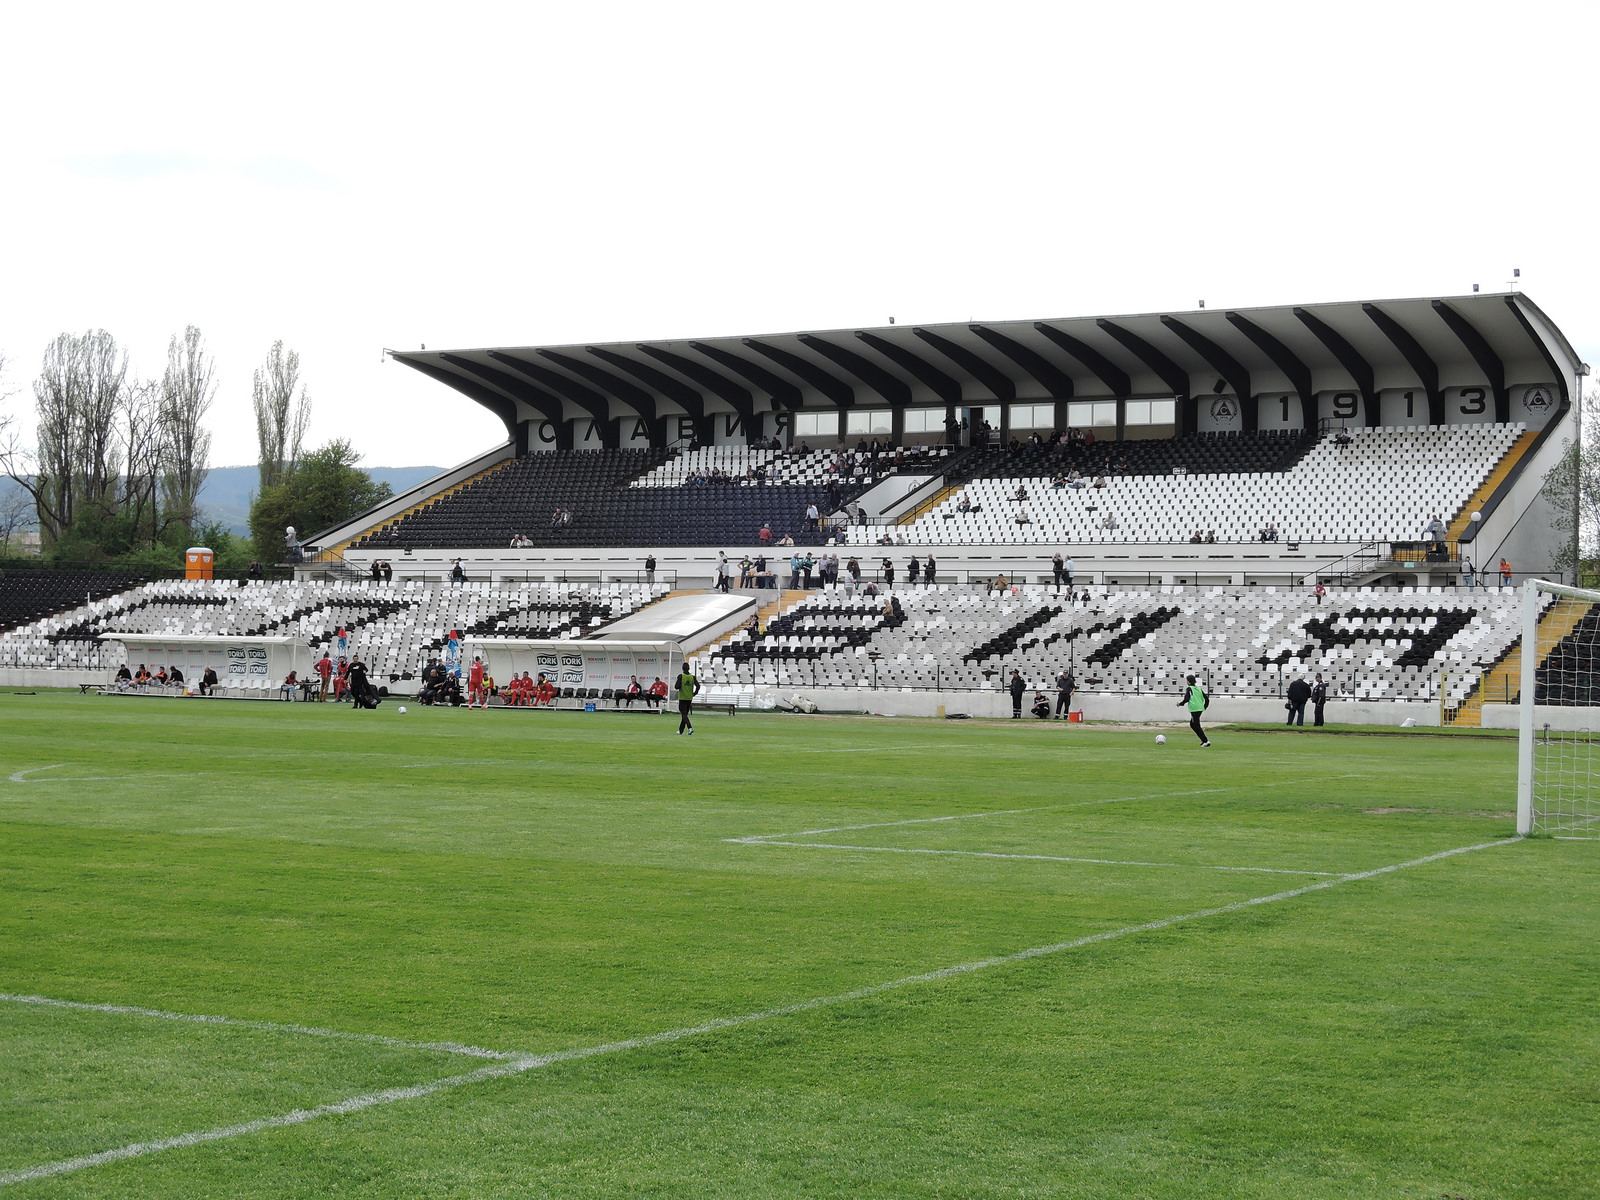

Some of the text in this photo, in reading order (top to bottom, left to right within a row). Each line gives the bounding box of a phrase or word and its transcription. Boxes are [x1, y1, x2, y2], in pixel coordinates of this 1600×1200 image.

[1279, 388, 1486, 422] 1913
[228, 650, 245, 658] TORK
[249, 650, 266, 658] TORK
[537, 656, 557, 665] TORK
[562, 656, 582, 666] TORK
[229, 665, 246, 673] TORK
[250, 665, 267, 673] TORK
[562, 672, 582, 682] TORK
